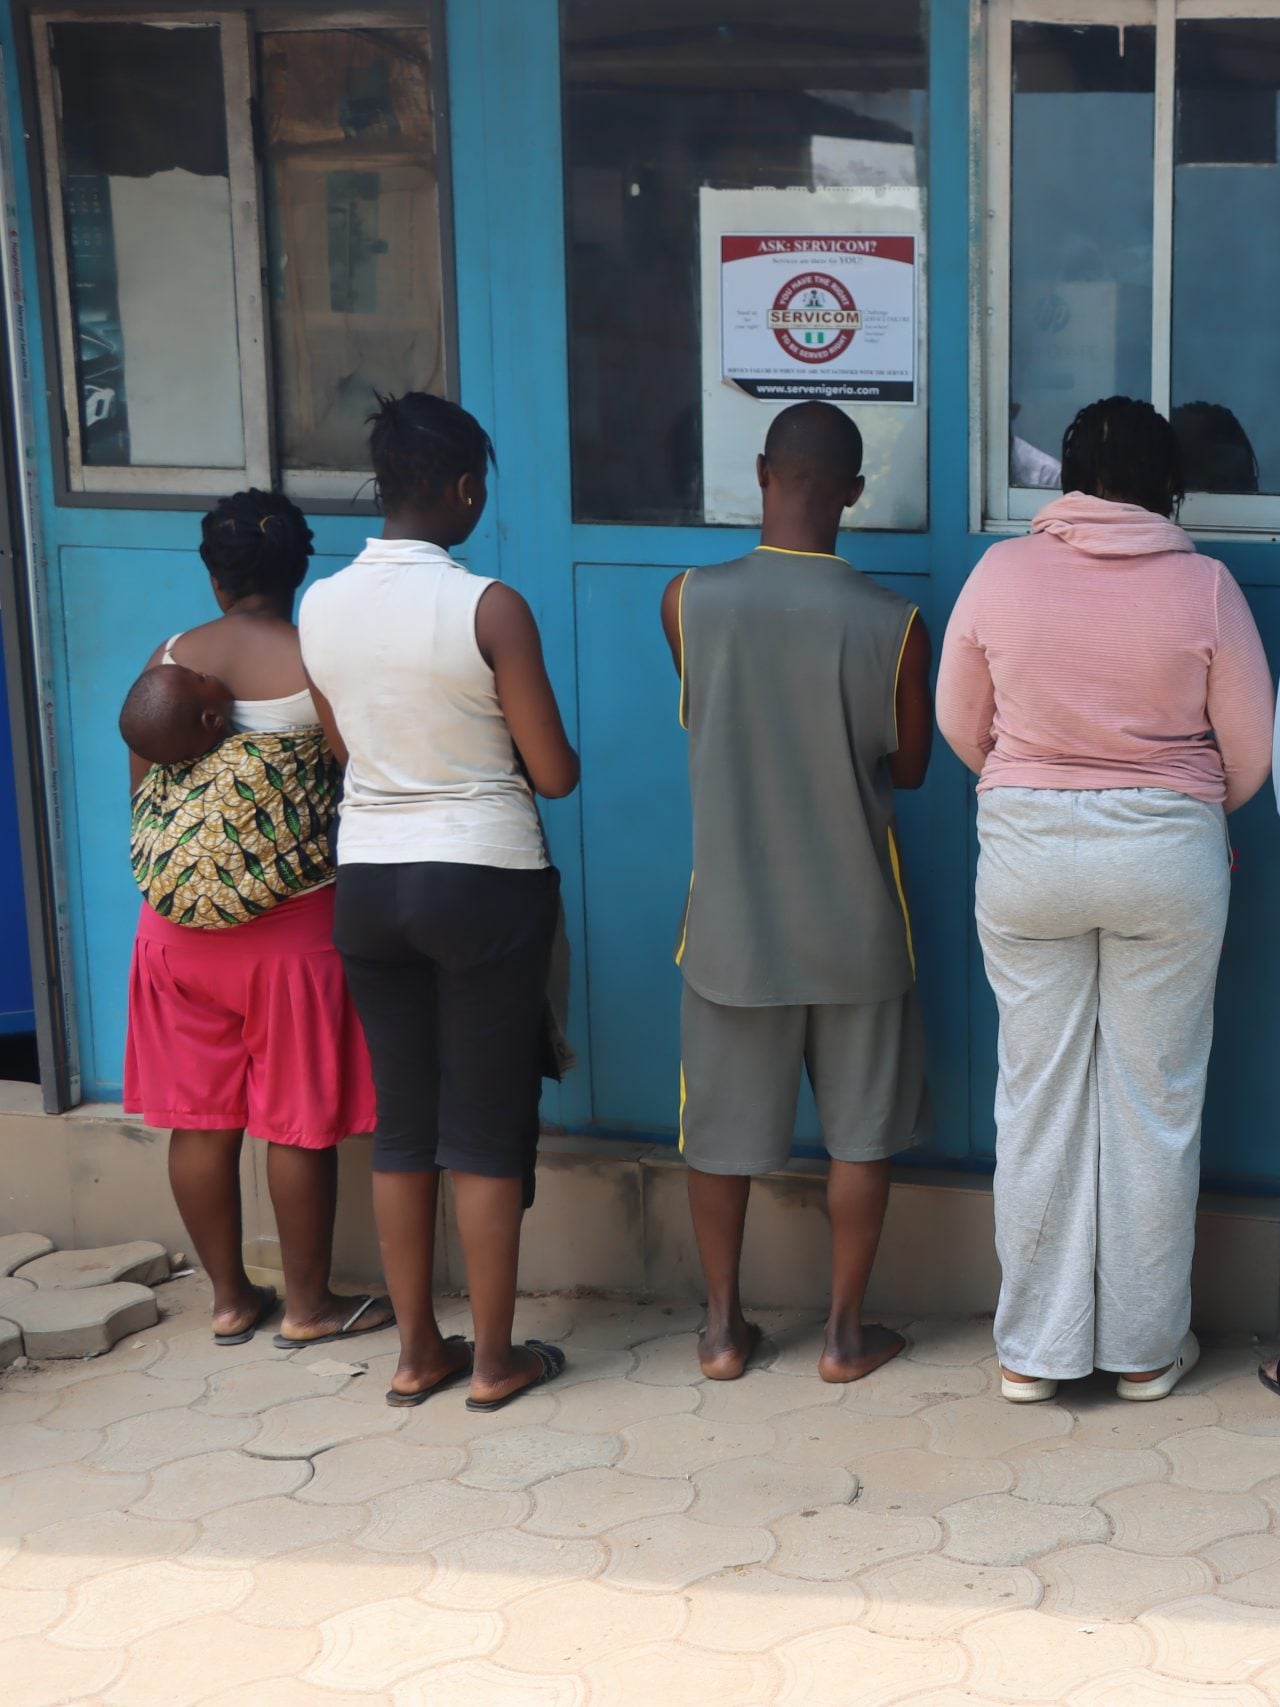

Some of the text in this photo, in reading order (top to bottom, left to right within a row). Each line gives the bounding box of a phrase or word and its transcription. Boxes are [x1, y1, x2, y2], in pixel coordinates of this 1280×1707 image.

[758, 240, 878, 253] ASK: SERVICOM?
[780, 275, 850, 305] YOU HAVE THE RIGHT
[771, 311, 860, 324] SERVICOM
[781, 334, 848, 360] TO BE SERVED RIGHT
[756, 383, 880, 397] www.servenigeria.com
